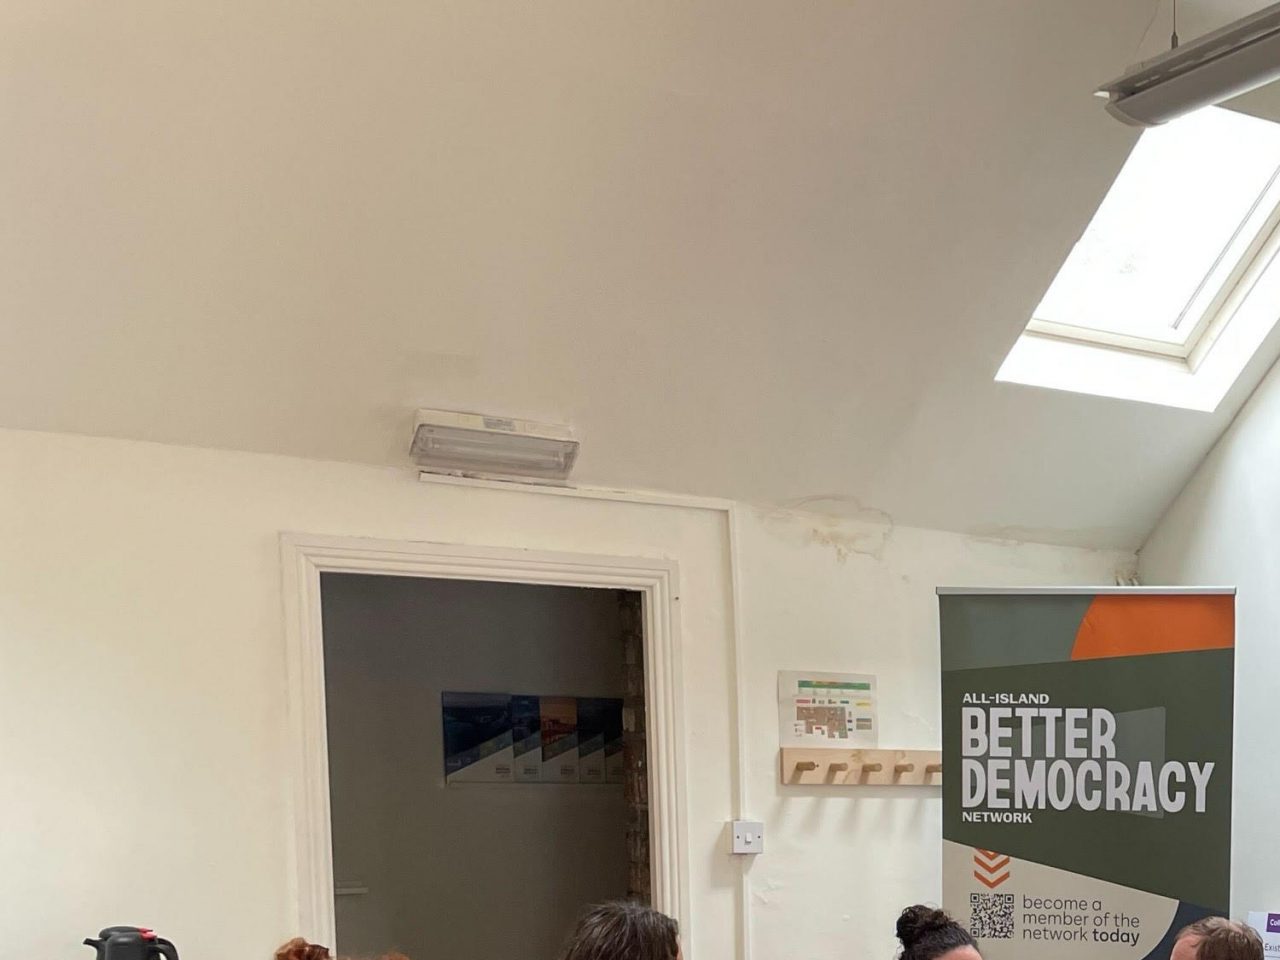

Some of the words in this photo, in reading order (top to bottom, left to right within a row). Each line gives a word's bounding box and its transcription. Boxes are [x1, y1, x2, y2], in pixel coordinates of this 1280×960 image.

[962, 693, 1050, 705] ALL-ISLAND
[961, 707, 1117, 759] BETTER
[961, 759, 1216, 813] DEMOCRACY
[962, 812, 1032, 824] NETWORK
[1023, 895, 1088, 911] become
[1092, 899, 1102, 910] a
[1023, 912, 1090, 926] member
[1093, 913, 1110, 926] of
[1114, 913, 1140, 928] the
[1023, 928, 1088, 941] network
[1093, 928, 1140, 946] today
